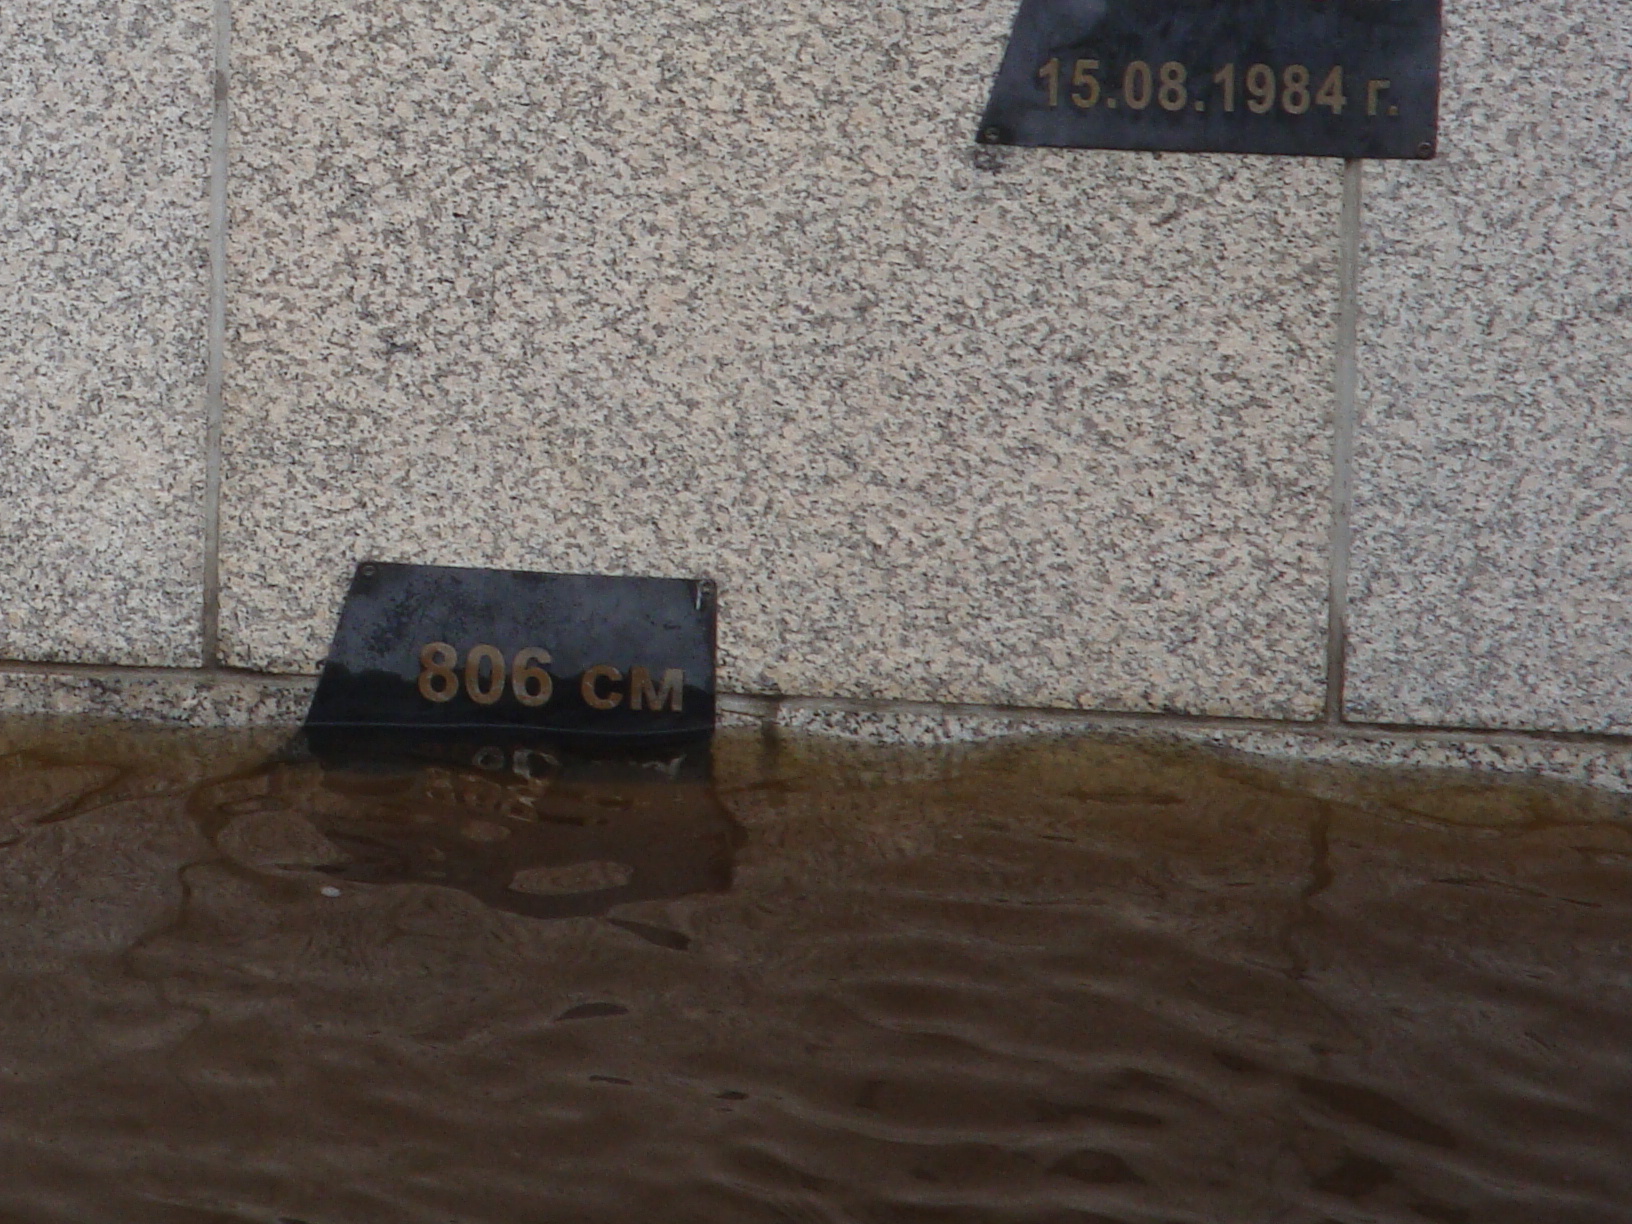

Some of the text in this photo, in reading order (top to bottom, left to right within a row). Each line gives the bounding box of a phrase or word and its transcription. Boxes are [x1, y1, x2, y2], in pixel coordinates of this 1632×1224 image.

[1038, 57, 1399, 117] 15.08.1984 г.
[417, 641, 554, 708] 806
